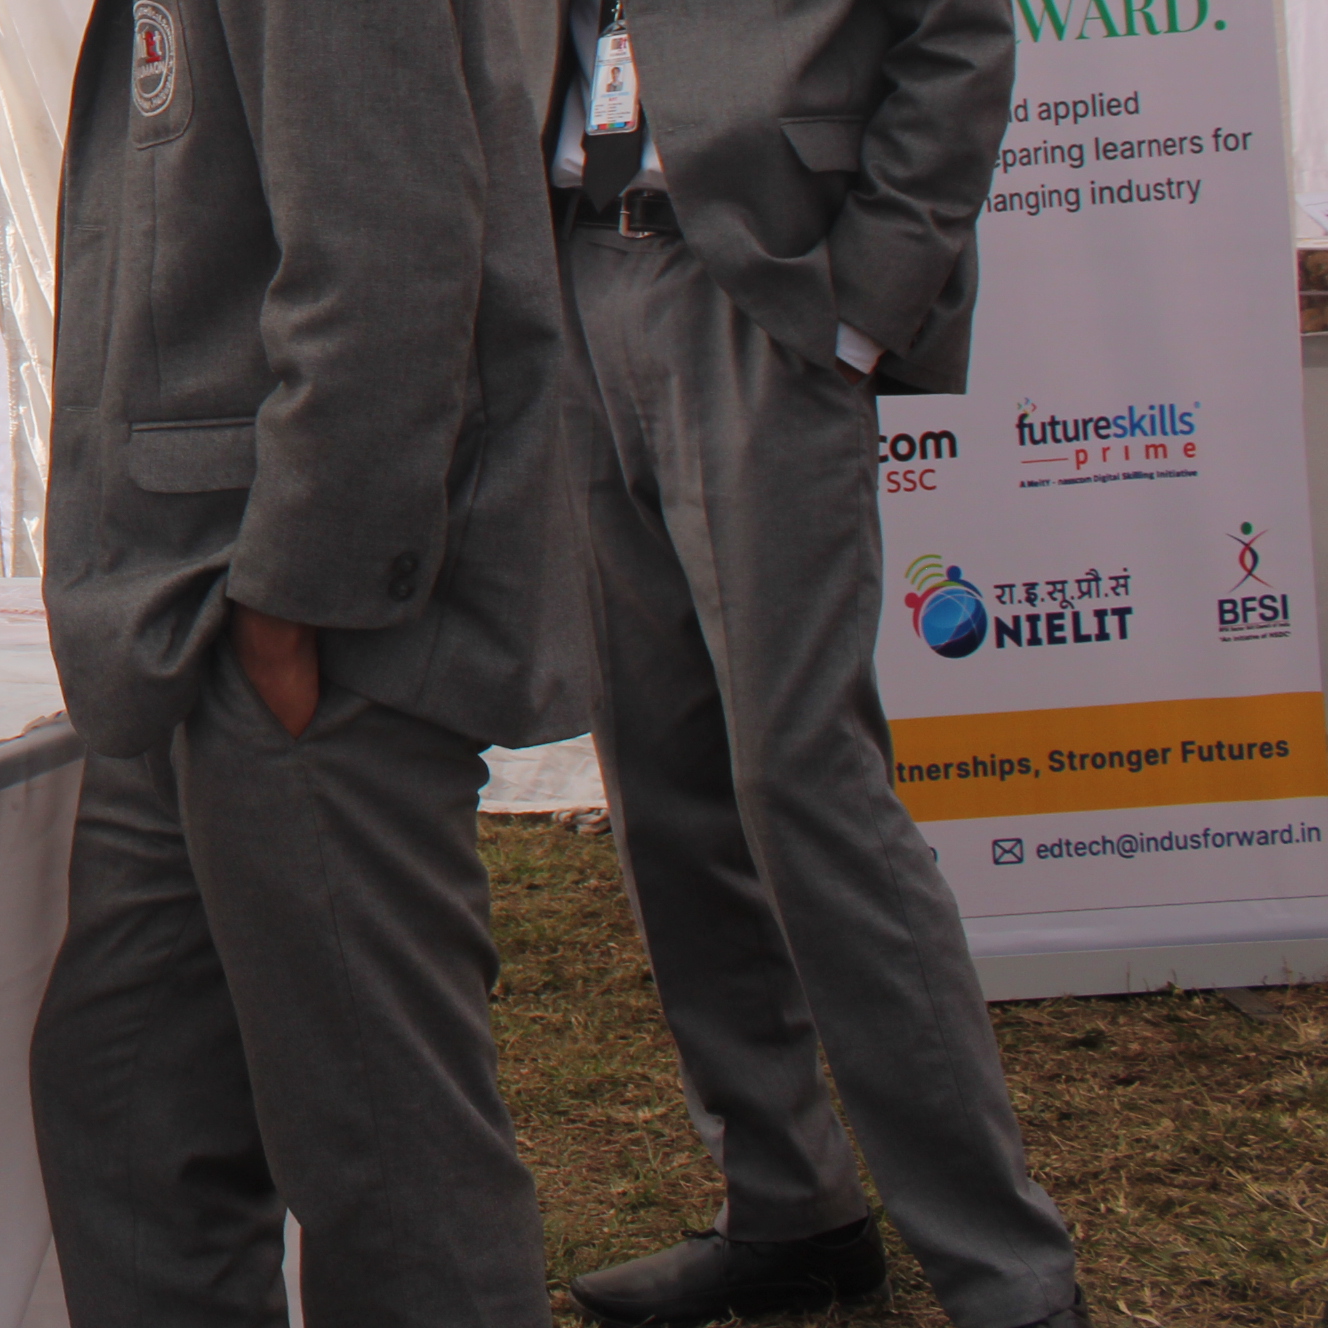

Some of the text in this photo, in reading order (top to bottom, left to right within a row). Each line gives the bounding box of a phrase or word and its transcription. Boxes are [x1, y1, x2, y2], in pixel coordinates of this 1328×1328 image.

[1038, 91, 1139, 126] applied
[1094, 131, 1203, 161] learners
[1212, 127, 1253, 153] for
[1090, 176, 1201, 205] industry
[1015, 403, 1196, 446] futureskills
[886, 468, 937, 493] SSC
[1094, 472, 1120, 483] Digital
[1217, 593, 1289, 625] BFSI
[994, 606, 1133, 648] NIELIT
[1048, 743, 1171, 773] Stronger
[1180, 737, 1290, 764] Futures
[1036, 821, 1322, 859] edtech@indusforward.in
